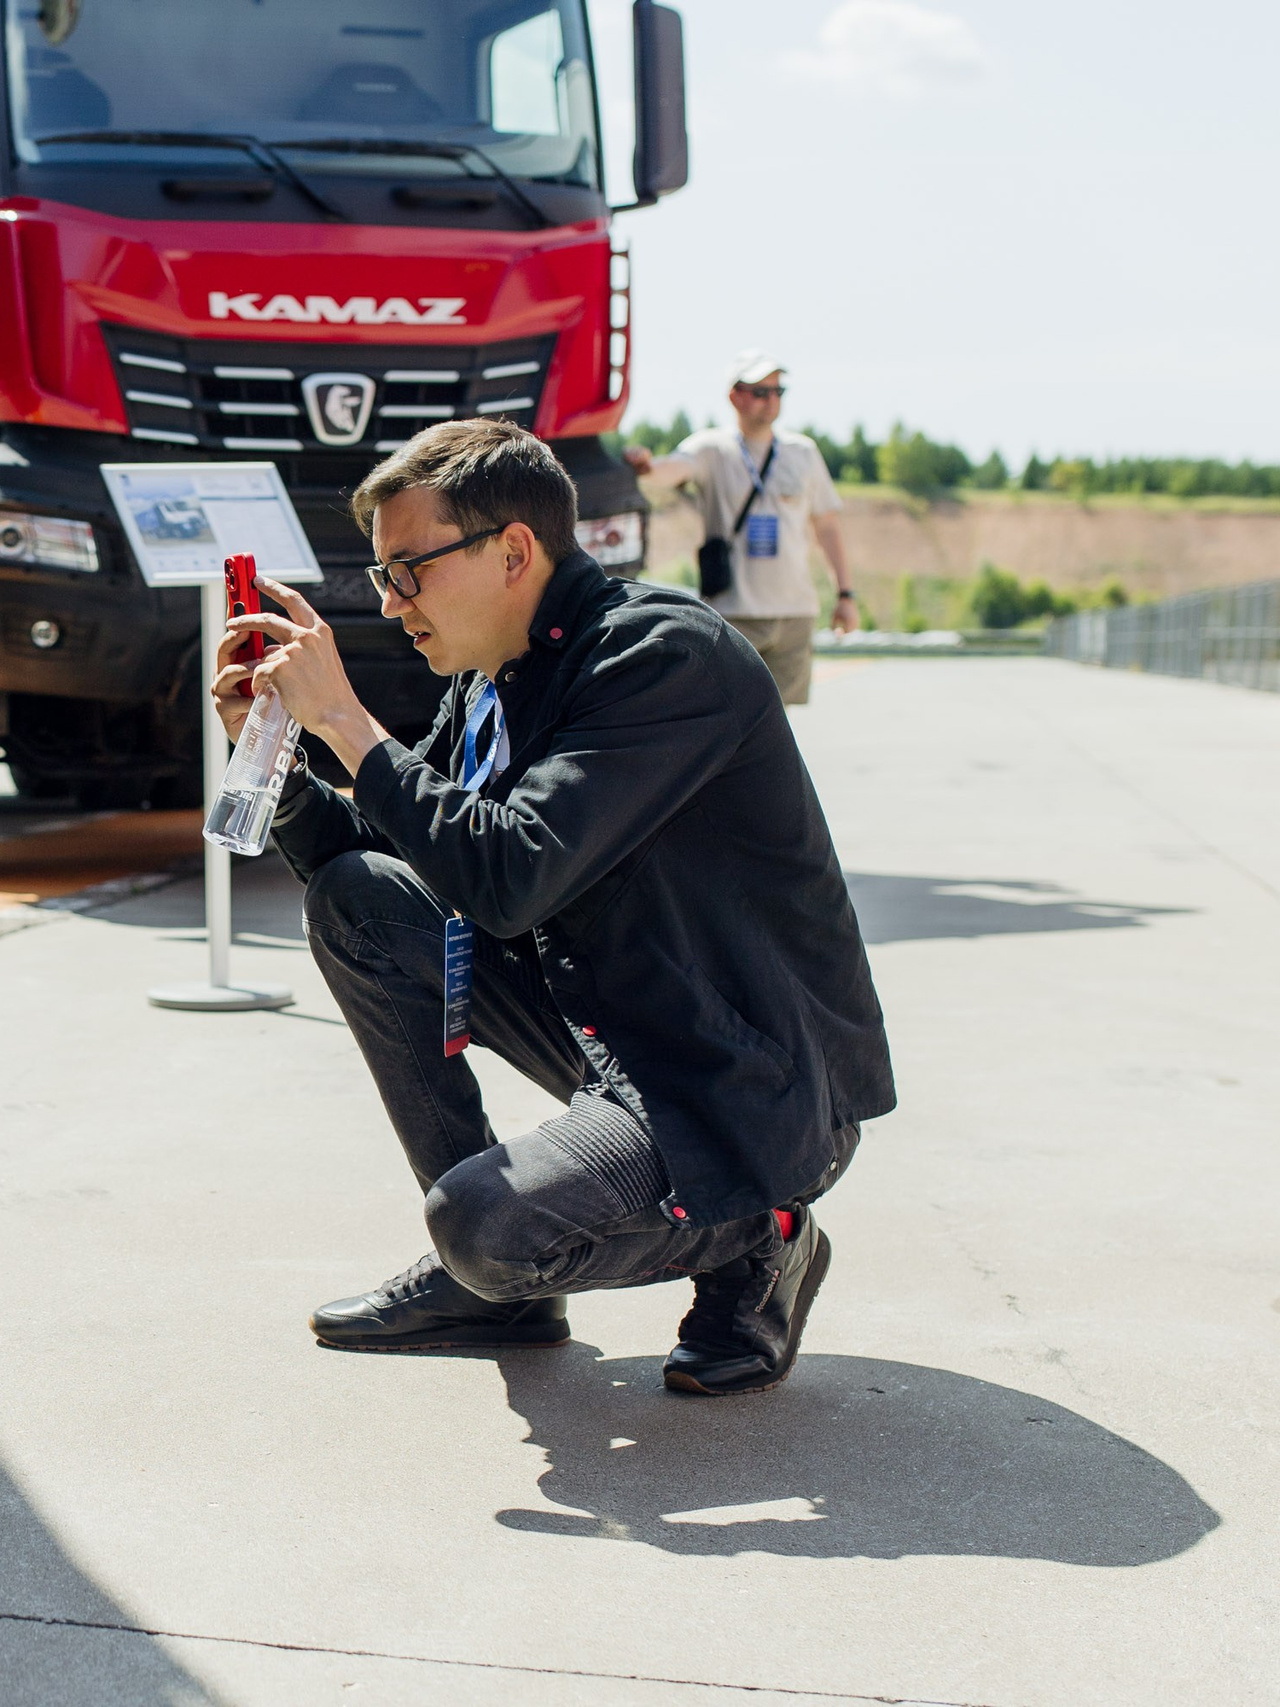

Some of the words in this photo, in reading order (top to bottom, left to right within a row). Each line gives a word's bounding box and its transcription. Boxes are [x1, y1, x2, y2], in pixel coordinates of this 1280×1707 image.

[208, 291, 467, 323] KAMAZ
[263, 717, 303, 808] IRBIS
[754, 1281, 776, 1313] Reebok
